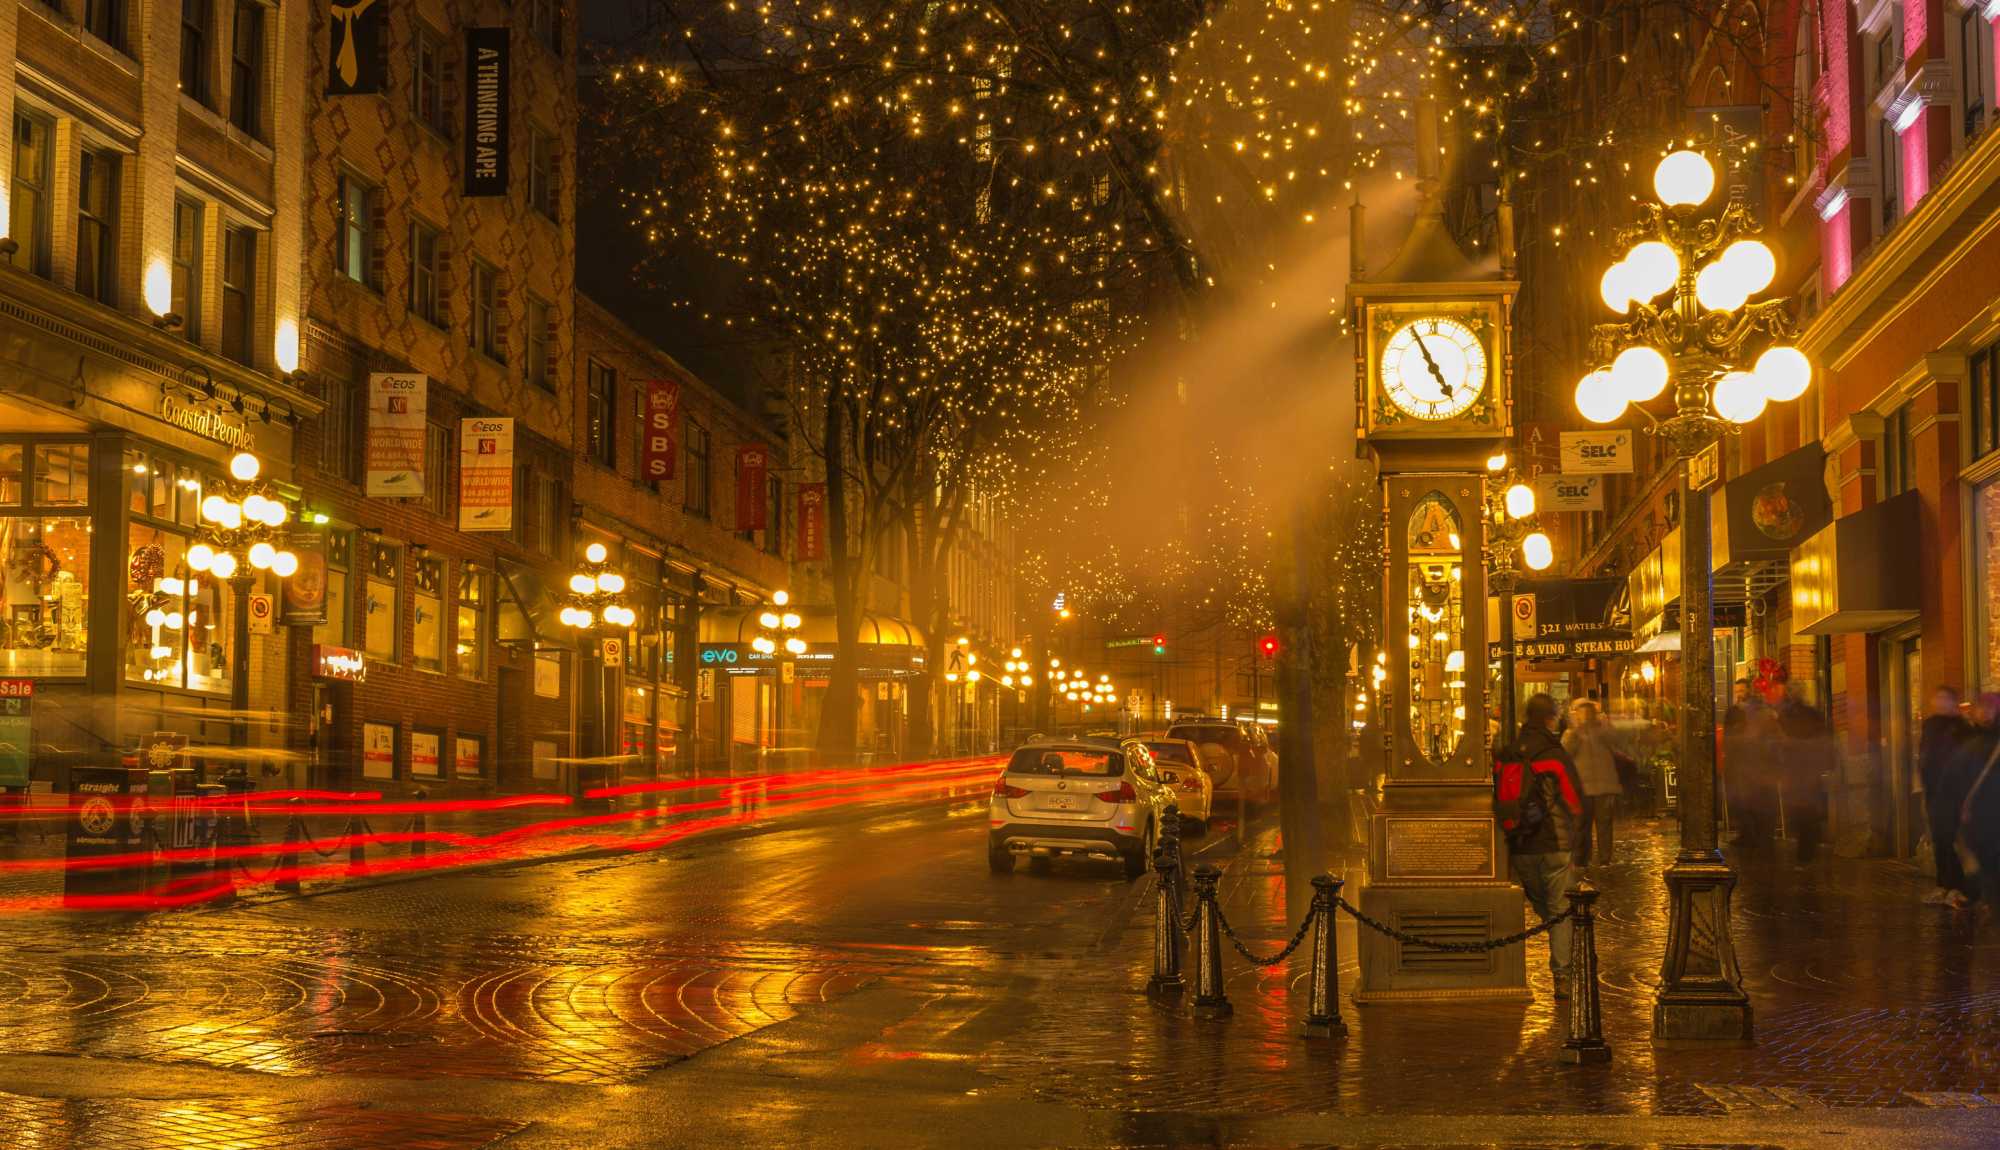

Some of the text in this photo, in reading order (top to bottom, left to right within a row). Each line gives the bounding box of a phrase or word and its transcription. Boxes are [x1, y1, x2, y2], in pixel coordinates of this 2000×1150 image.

[476, 48, 498, 177] A THINKING APE
[163, 396, 255, 451] Coastal Peoples
[370, 439, 423, 449] WORLDWIDE
[1580, 445, 1617, 458] SELC
[1557, 486, 1589, 497] SELC
[1540, 624, 1560, 636] 321
[1538, 643, 1565, 655] VINO
[1575, 640, 1612, 653] STEAK
[703, 648, 737, 663] evo
[0, 681, 31, 695] Sale
[79, 783, 120, 794] straight
